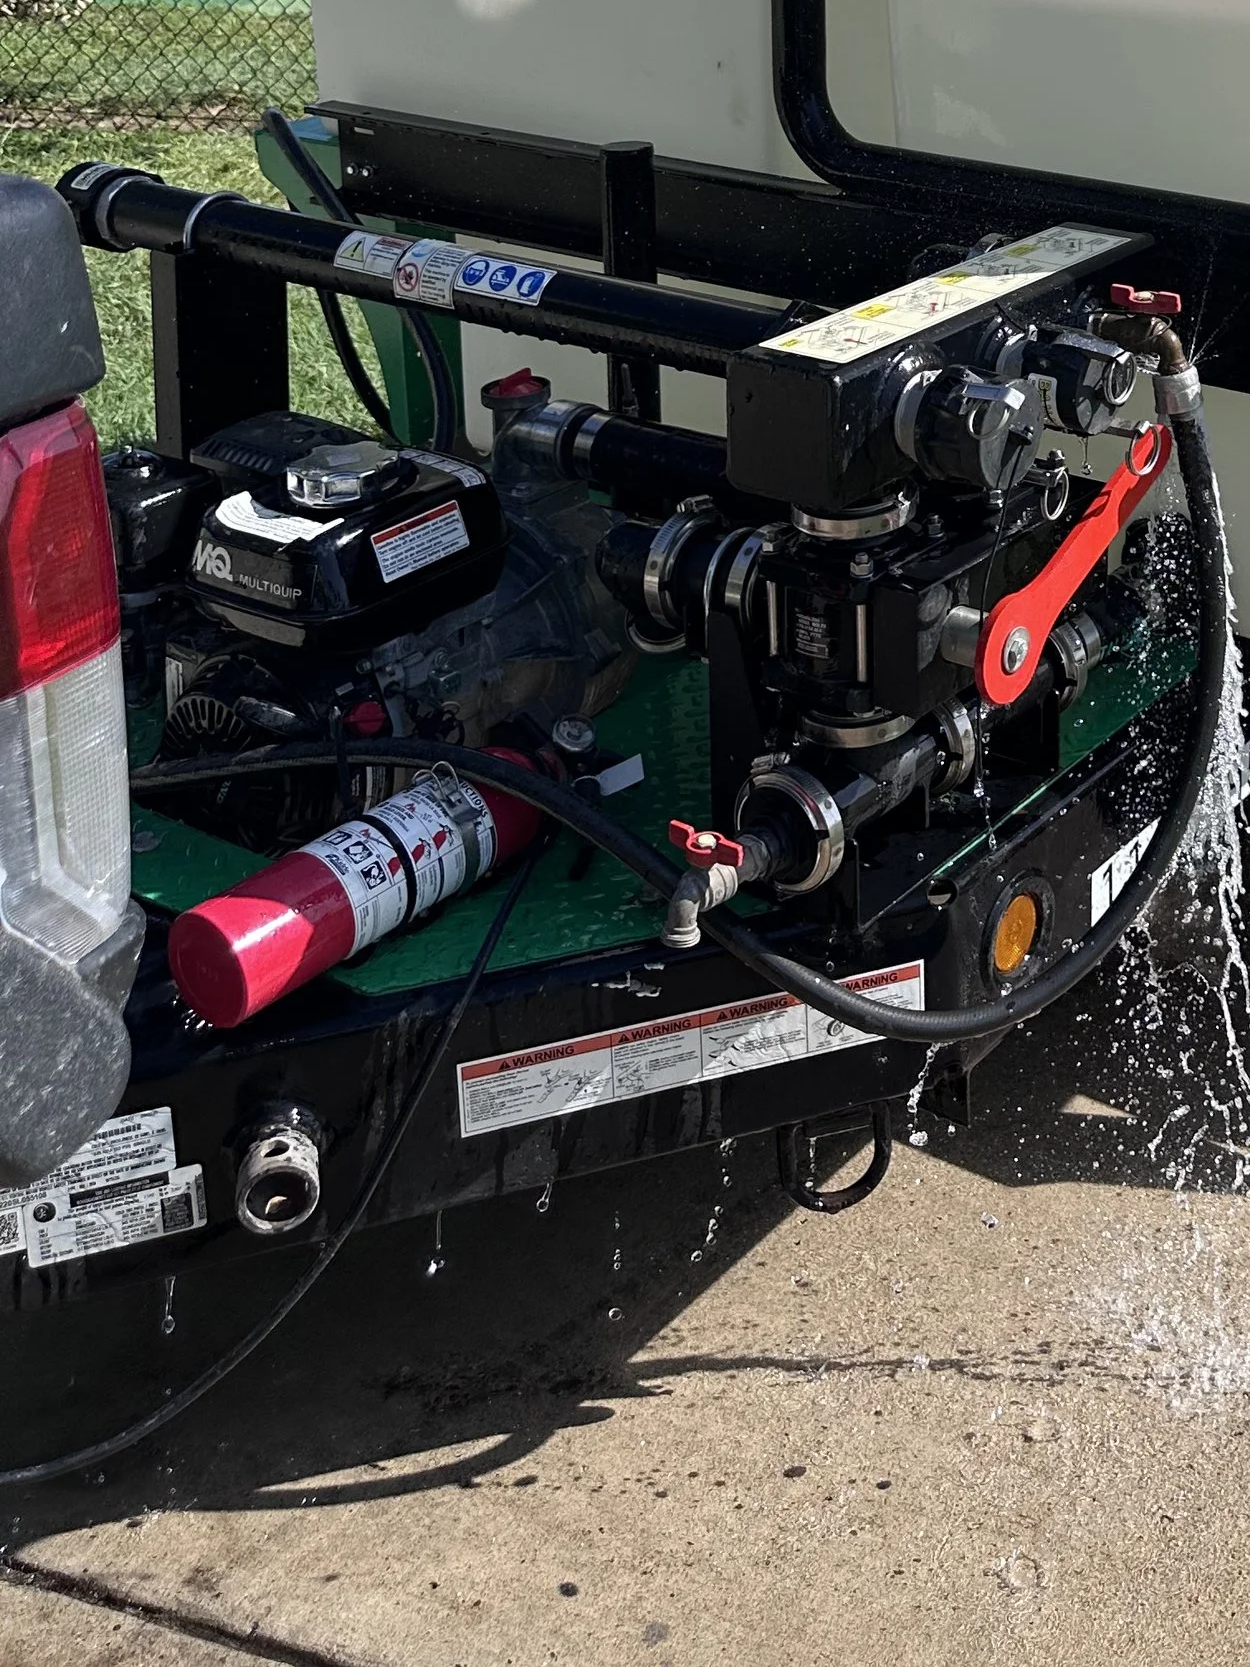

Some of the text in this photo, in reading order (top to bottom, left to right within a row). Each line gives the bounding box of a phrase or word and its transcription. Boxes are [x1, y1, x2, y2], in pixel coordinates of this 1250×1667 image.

[192, 540, 233, 582] MQ
[239, 574, 302, 601] MULTIQUIP
[460, 782, 489, 819] UCTIONS
[728, 996, 788, 1019] WARNING
[632, 1018, 692, 1041] WARNING
[511, 1045, 575, 1068] WARNING
